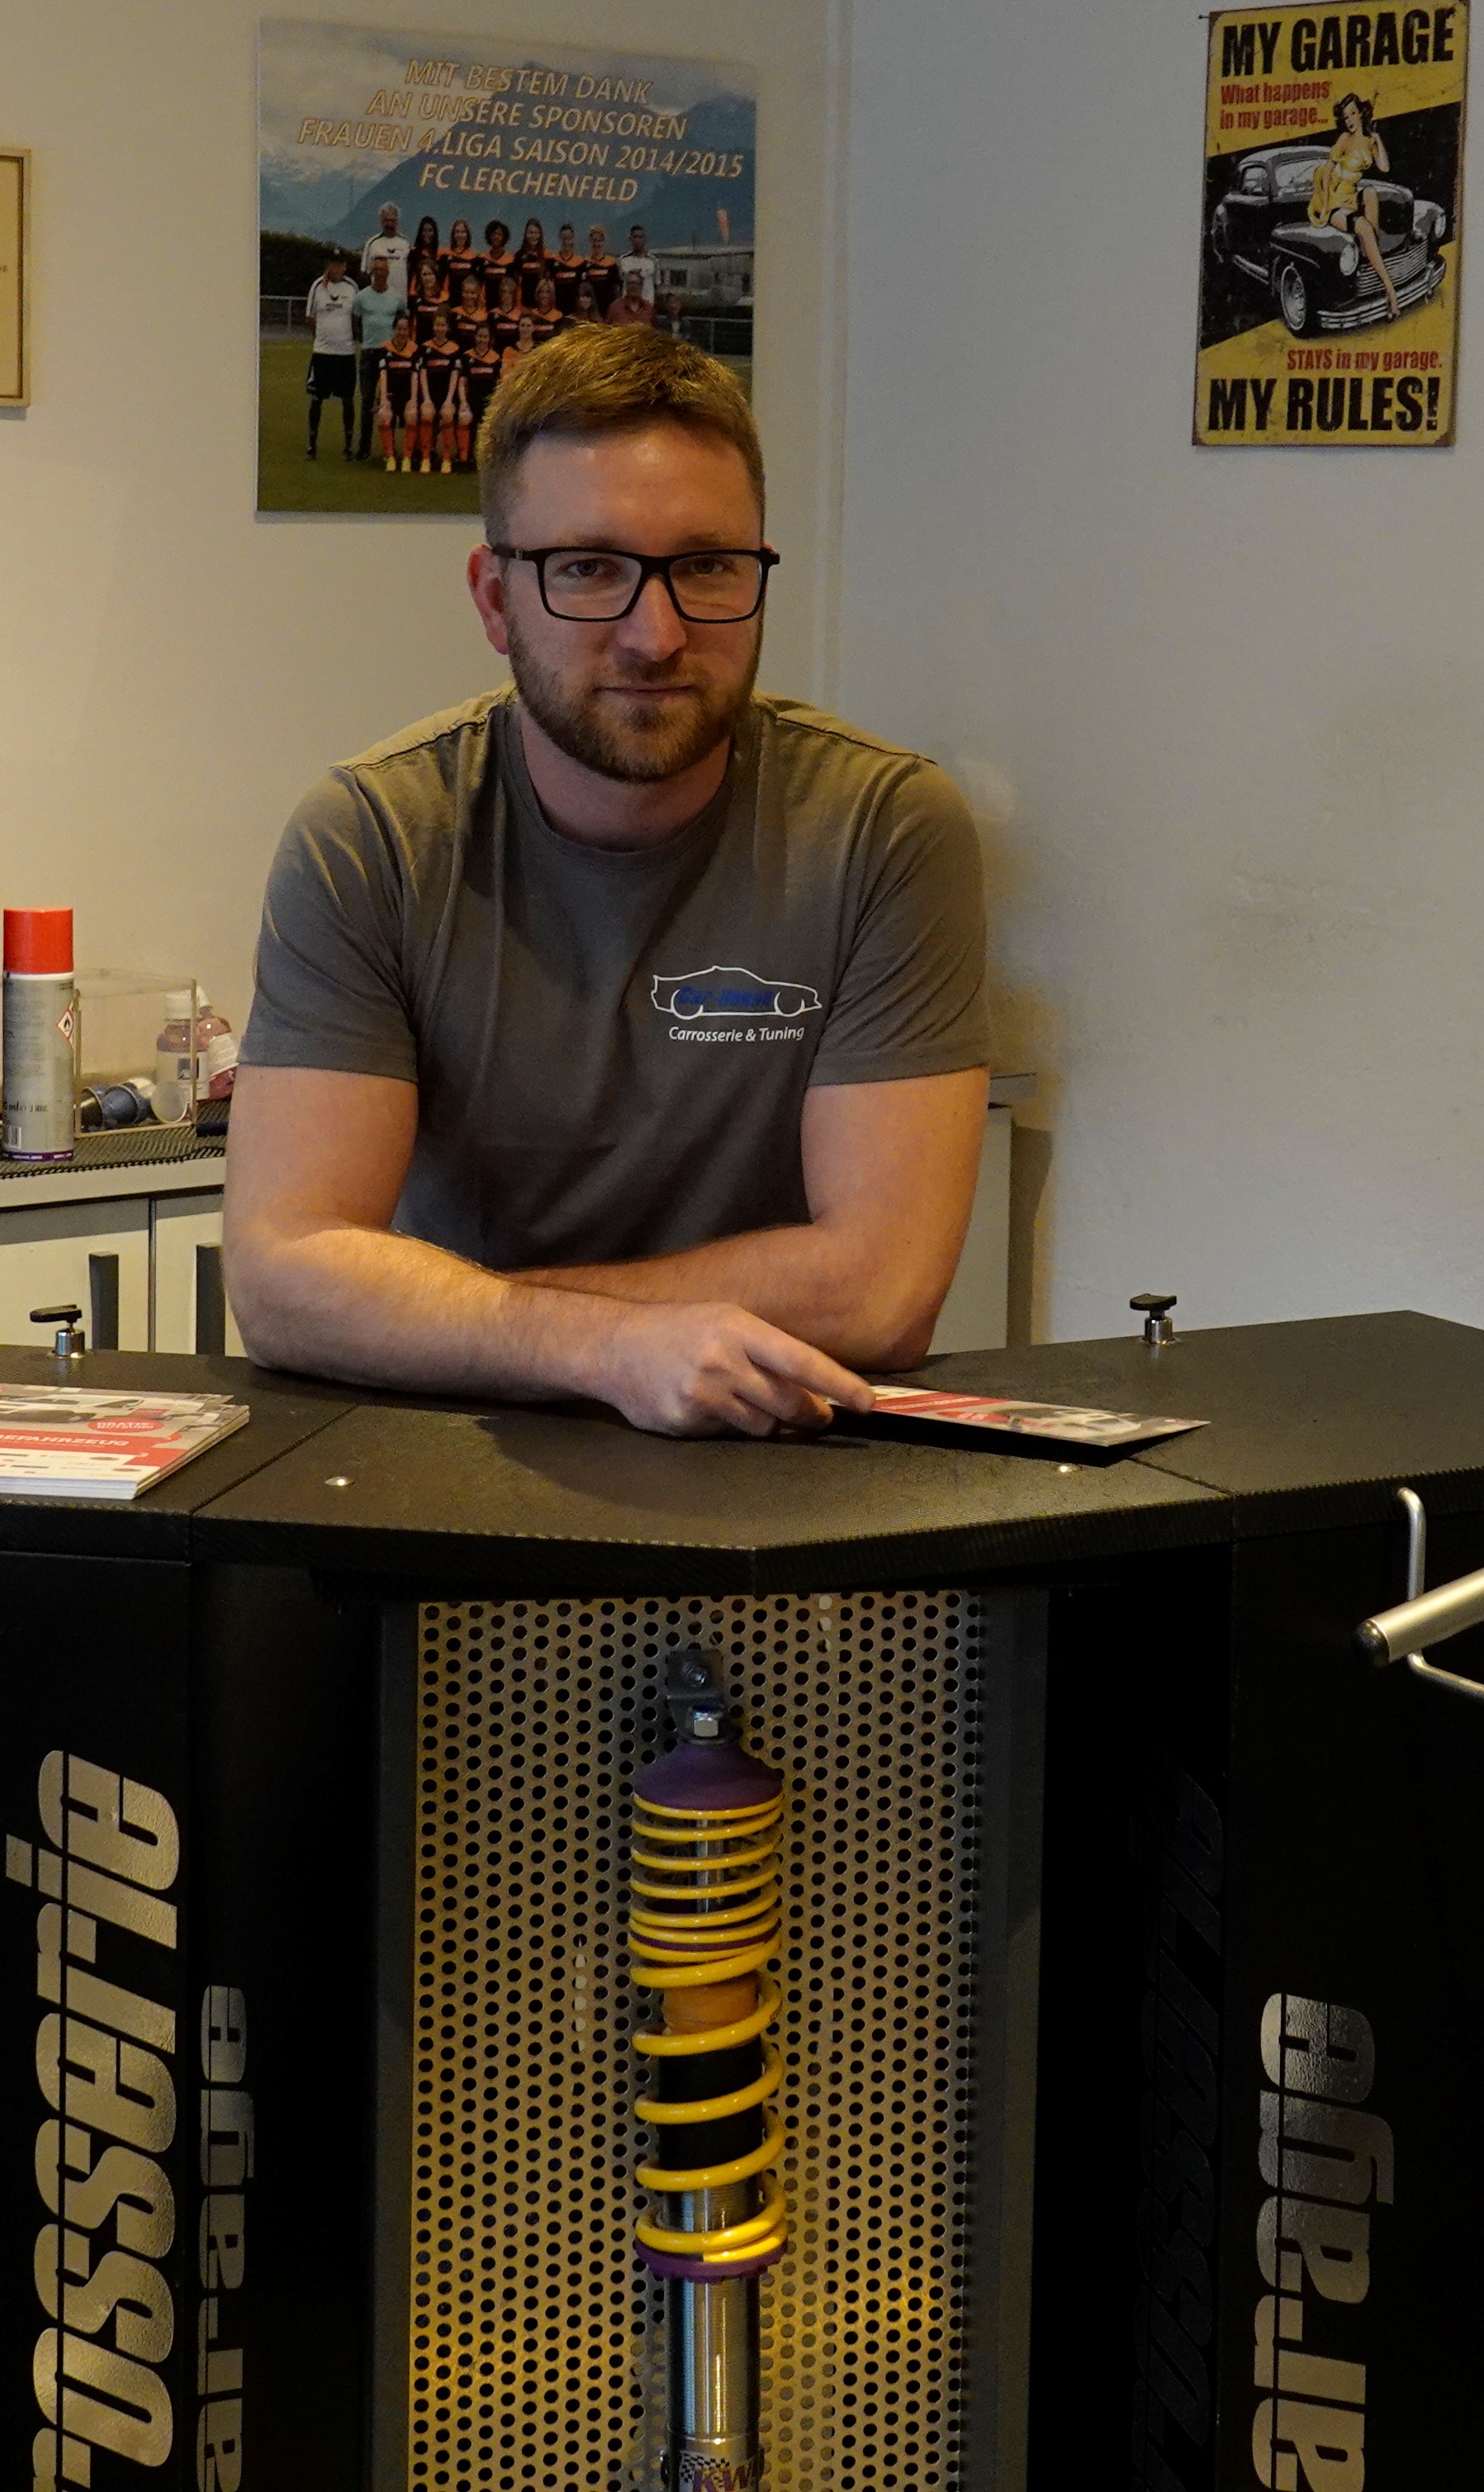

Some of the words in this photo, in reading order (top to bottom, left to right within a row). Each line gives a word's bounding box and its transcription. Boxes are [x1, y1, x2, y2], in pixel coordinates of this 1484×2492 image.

[1221, 21, 1282, 78] MY
[1290, 7, 1456, 73] GARAGE
[405, 59, 460, 87] MIT
[465, 64, 569, 97] BESTEM
[576, 72, 654, 104] DANK
[1221, 83, 1259, 105] What
[1263, 81, 1331, 104] happens
[366, 88, 412, 118] AN
[419, 93, 524, 126] UNSERE
[529, 102, 688, 140] SPONSOREN
[1220, 108, 1234, 130] in
[1238, 107, 1261, 129] my
[1264, 105, 1329, 130] garage...
[297, 116, 414, 152] FRAUEN
[510, 135, 609, 168] SAISON
[615, 145, 744, 178] 2014/2015
[419, 162, 454, 190] FC
[459, 165, 638, 202] LERCHENFELD
[1287, 349, 1332, 370] STAYS
[1336, 349, 1351, 369] in
[1355, 351, 1379, 371] my
[1382, 350, 1443, 372] garage.
[1208, 377, 1278, 430] MY
[1287, 376, 1440, 431] RULES!
[669, 1026, 742, 1042] Carrosserie
[745, 1028, 756, 1042] &
[759, 1026, 805, 1041] Tuning
